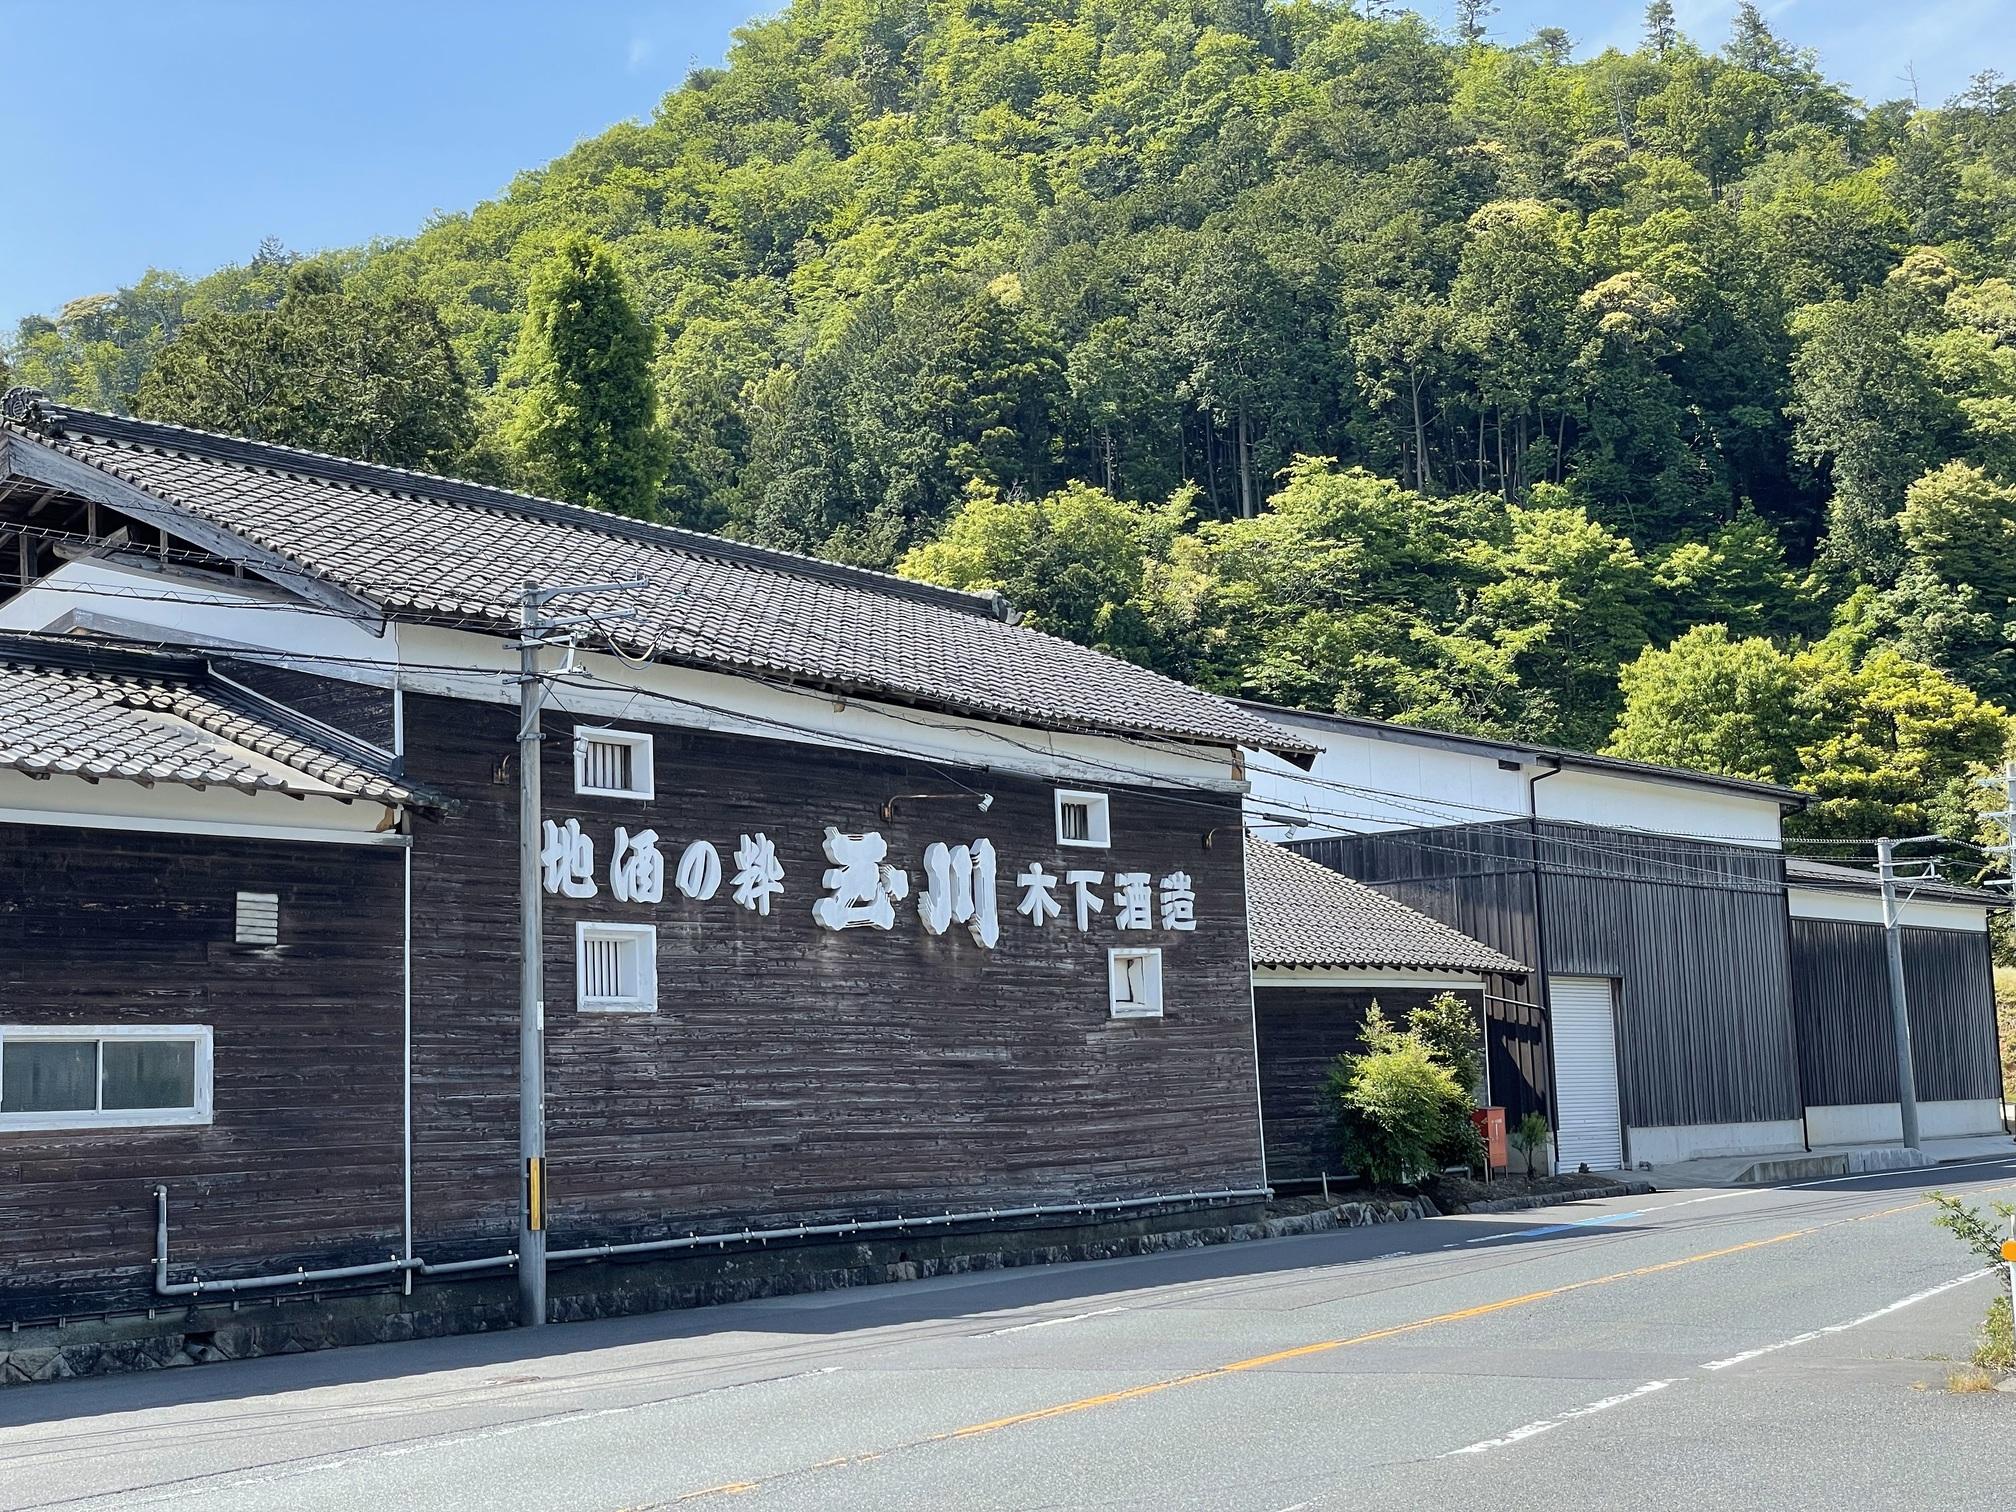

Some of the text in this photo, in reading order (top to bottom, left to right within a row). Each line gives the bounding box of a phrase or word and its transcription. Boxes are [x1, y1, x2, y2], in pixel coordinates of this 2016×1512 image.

[812, 826, 999, 949] 玉川
[1017, 862, 1197, 932] 木下酒造
